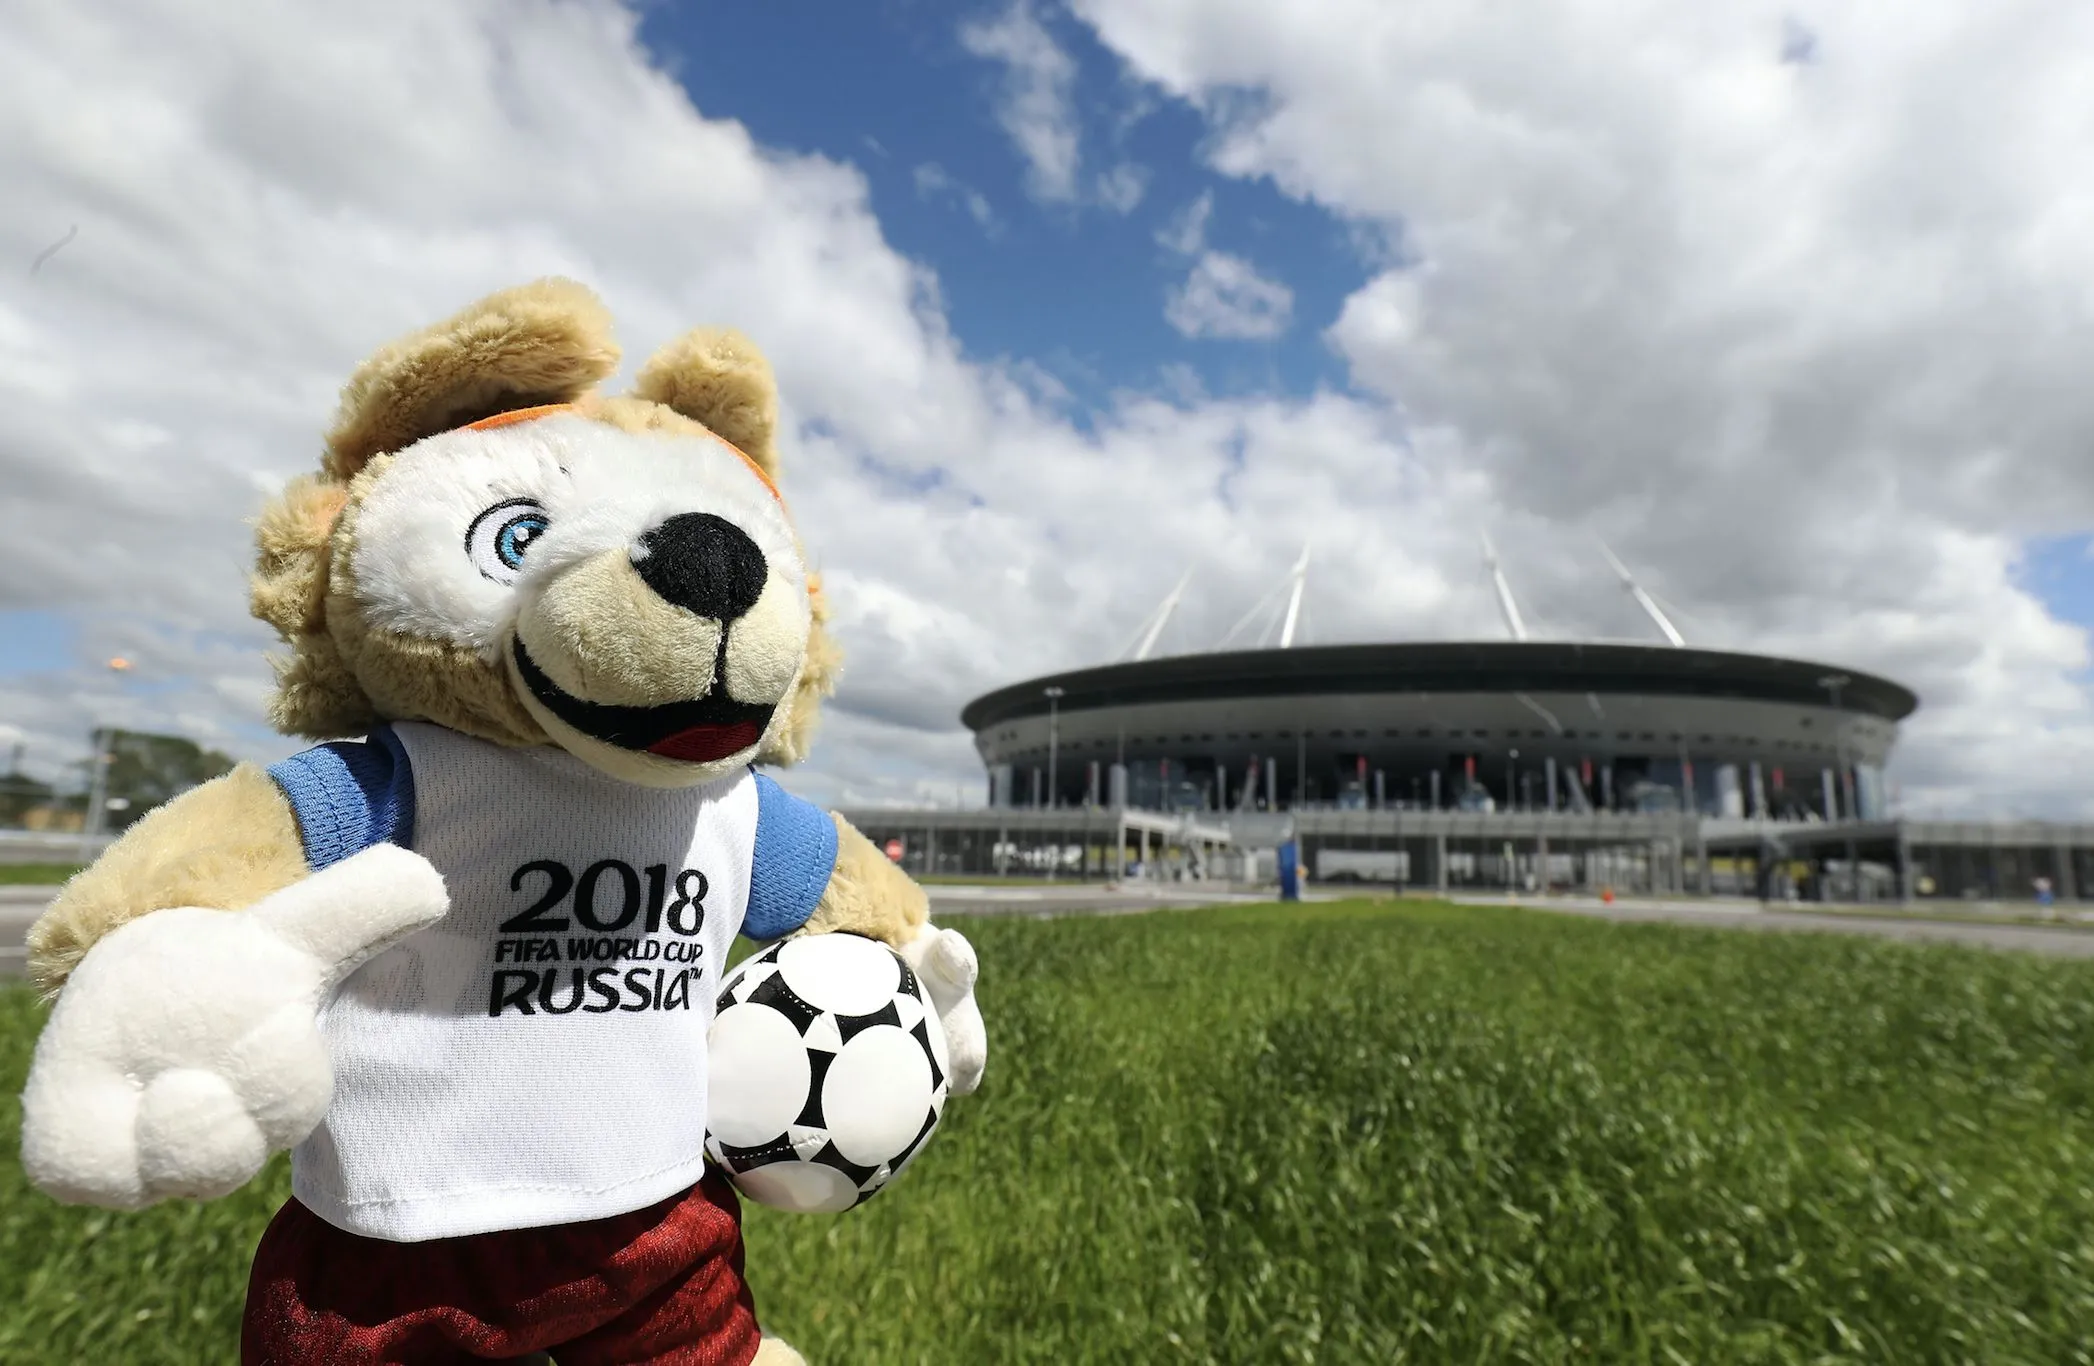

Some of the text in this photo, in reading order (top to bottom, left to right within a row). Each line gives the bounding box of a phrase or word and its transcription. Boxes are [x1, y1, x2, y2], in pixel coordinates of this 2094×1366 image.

[500, 859, 708, 936] 2018
[495, 938, 703, 963] FIFA WORLD CUP
